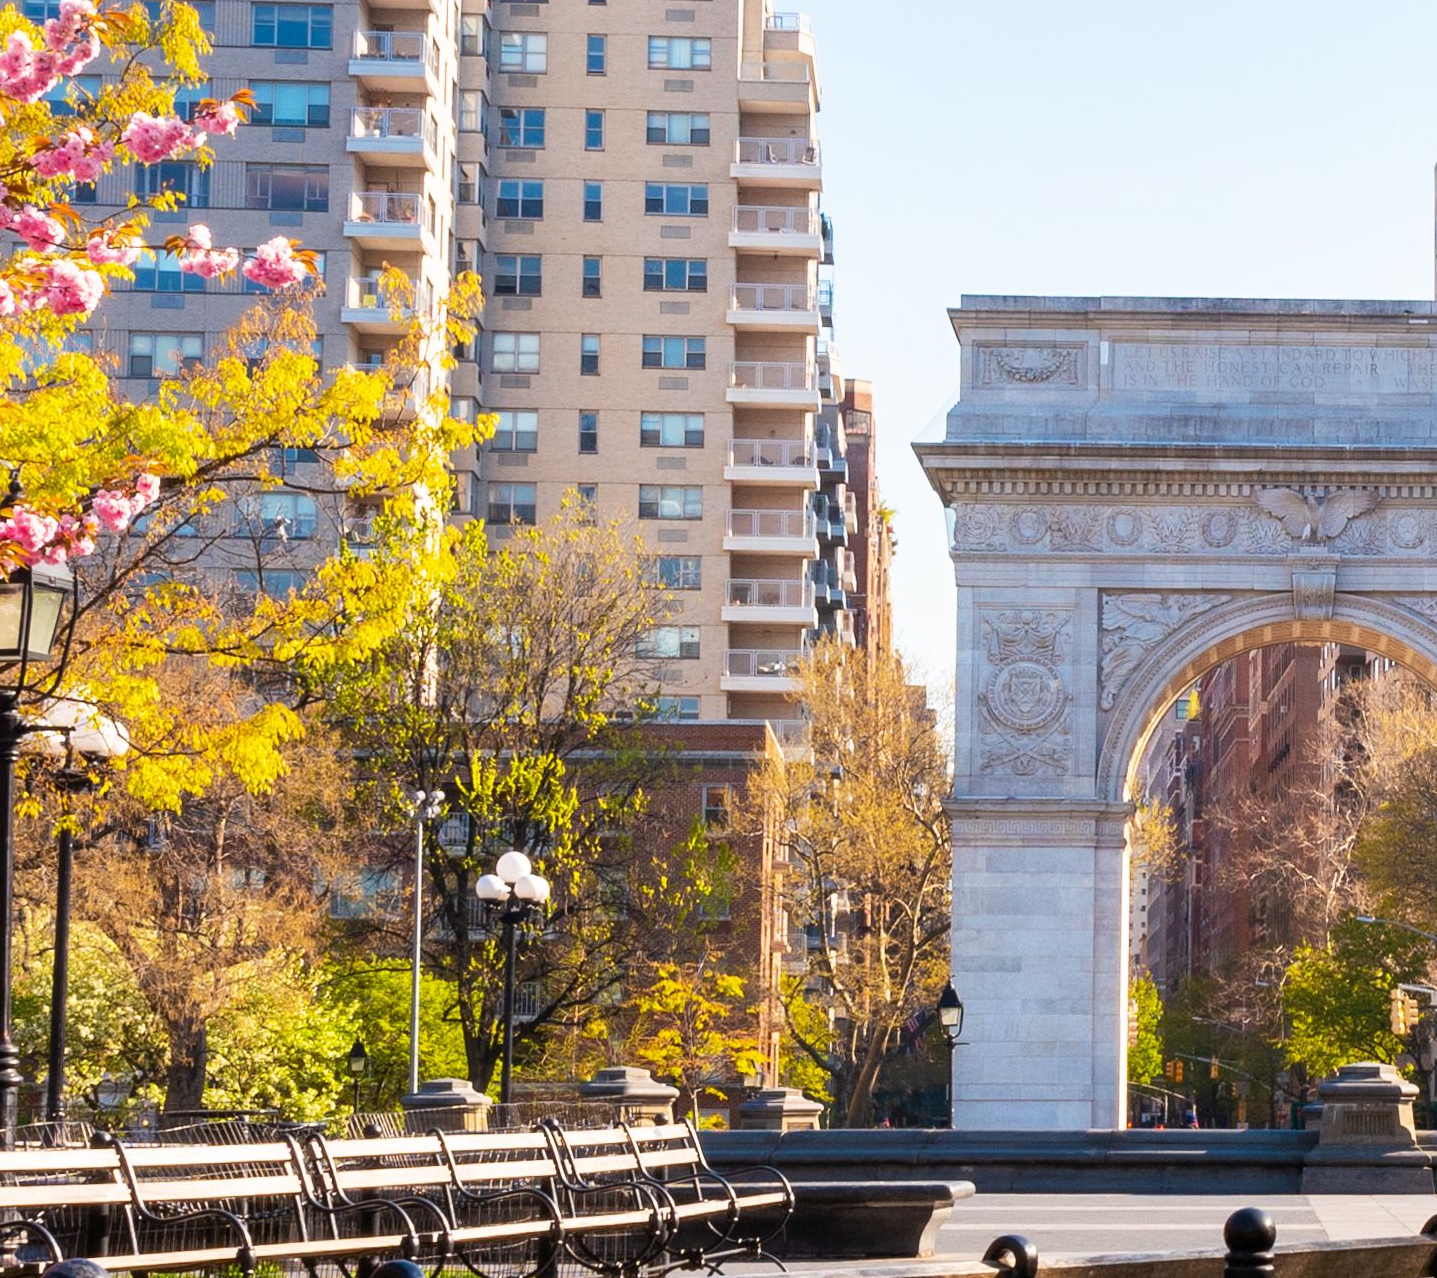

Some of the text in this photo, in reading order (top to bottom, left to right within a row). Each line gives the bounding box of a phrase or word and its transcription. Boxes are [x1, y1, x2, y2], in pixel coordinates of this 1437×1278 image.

[1159, 346, 1177, 359] US
[1234, 347, 1243, 360] A
[1342, 348, 1364, 362] TO
[1369, 348, 1423, 362] WHICH
[1122, 360, 1155, 372] AND
[1162, 360, 1194, 373] THE
[1205, 361, 1270, 374] HONEST
[1279, 362, 1315, 374] CAN
[1322, 362, 1378, 376] REPAIR
[1124, 374, 1136, 386] IS
[1144, 374, 1159, 387] IN
[1165, 374, 1197, 387] THE
[1206, 374, 1253, 387] HAND
[1289, 376, 1324, 388] GOD
